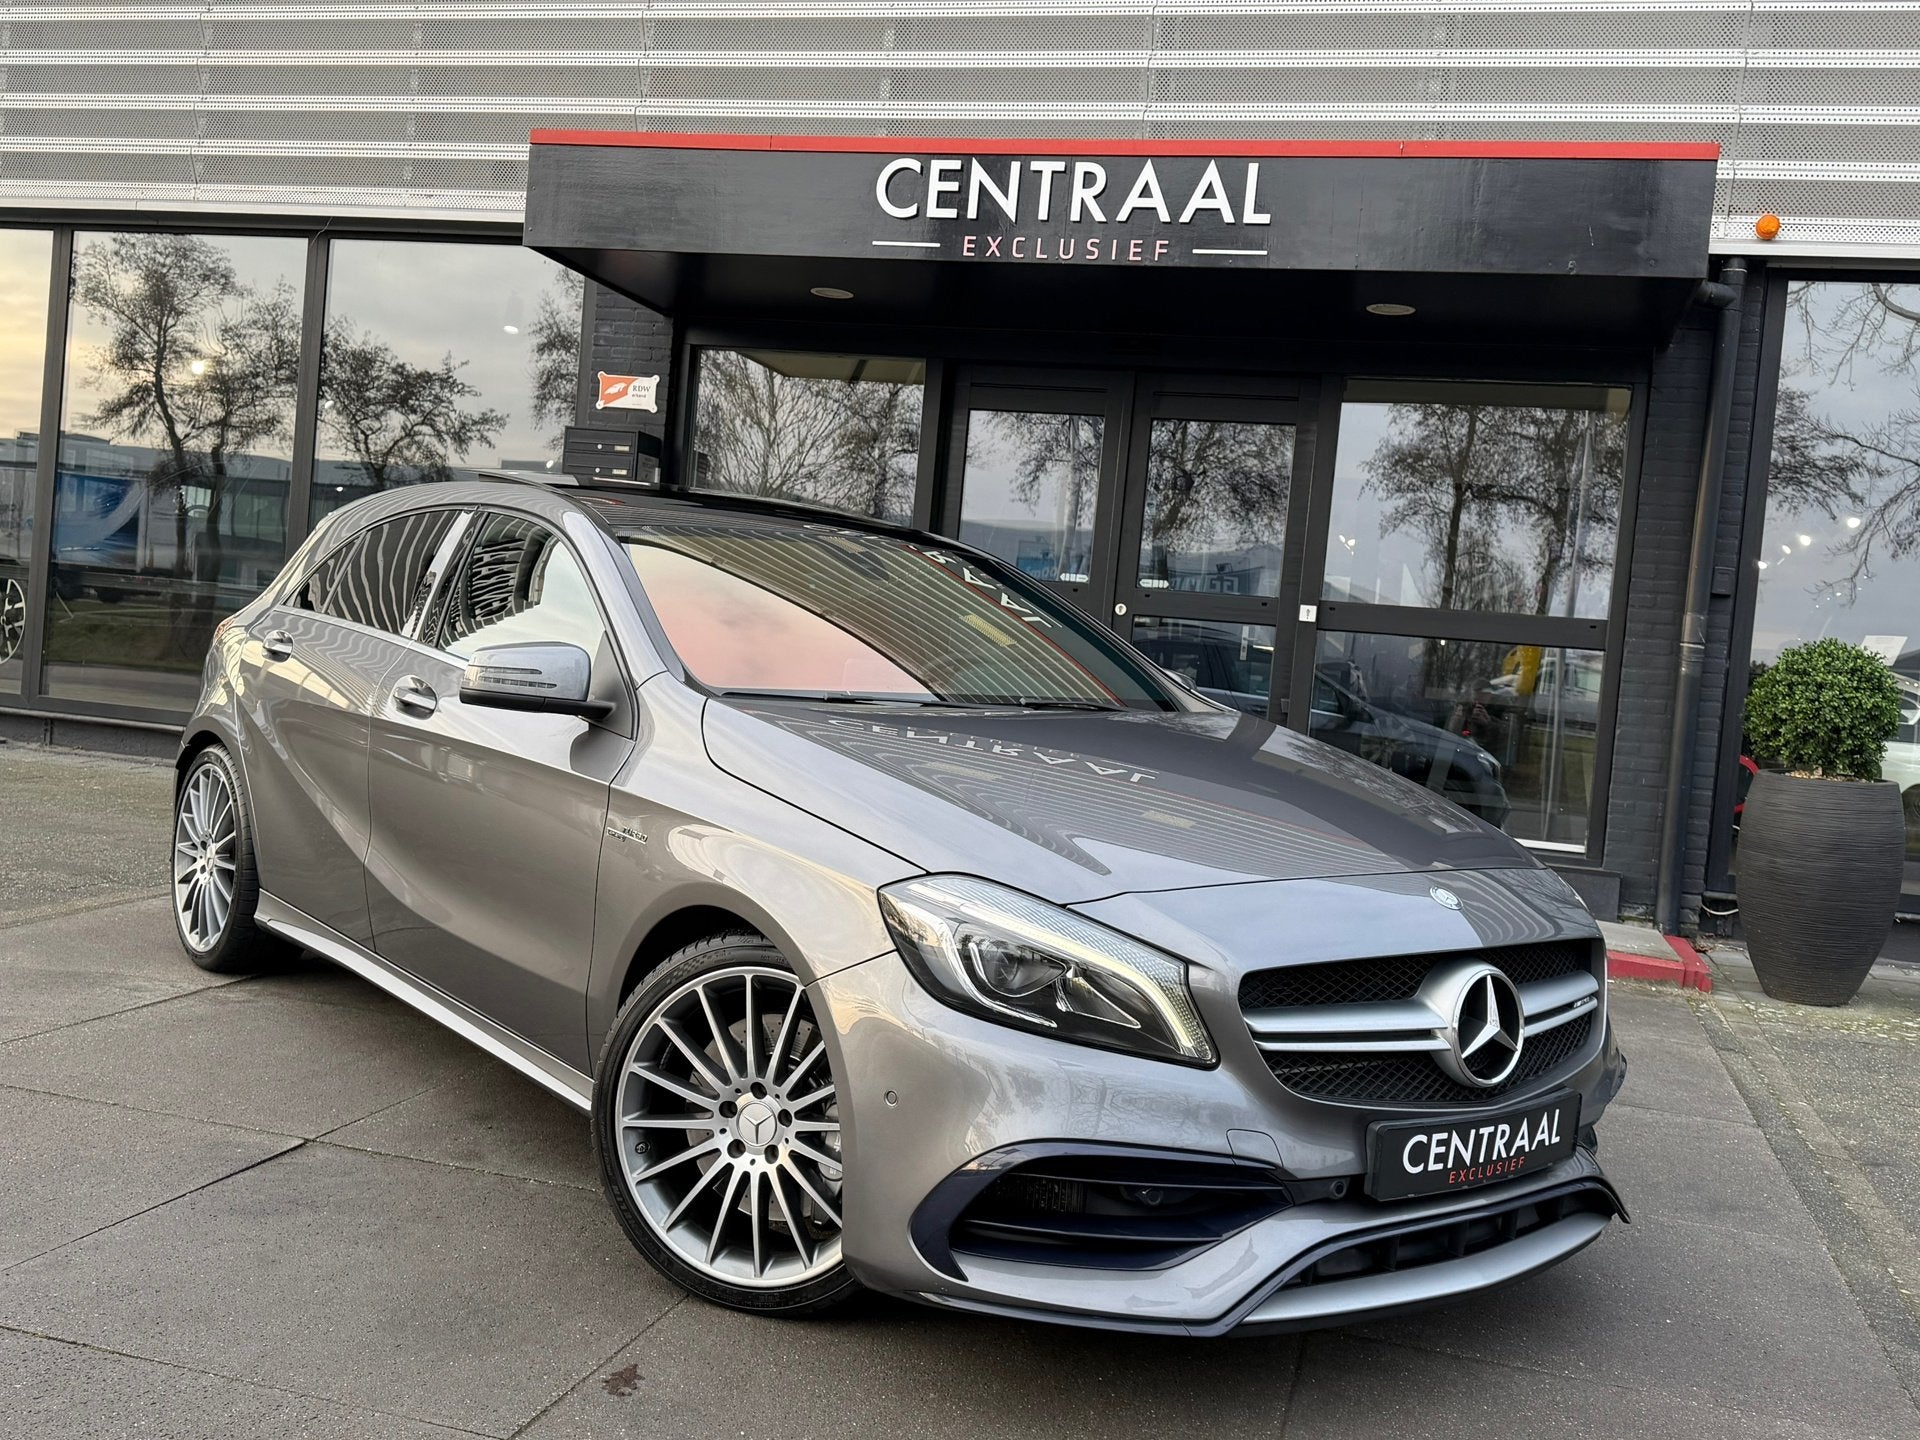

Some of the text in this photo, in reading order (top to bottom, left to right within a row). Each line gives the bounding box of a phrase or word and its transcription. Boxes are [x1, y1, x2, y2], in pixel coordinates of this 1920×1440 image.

[875, 158, 1271, 224] CENTRAAL
[962, 235, 1169, 261] EXCLUSIEF
[1402, 1109, 1560, 1174] CENTRAAL
[1449, 1156, 1525, 1184] EXCLUSIEF
